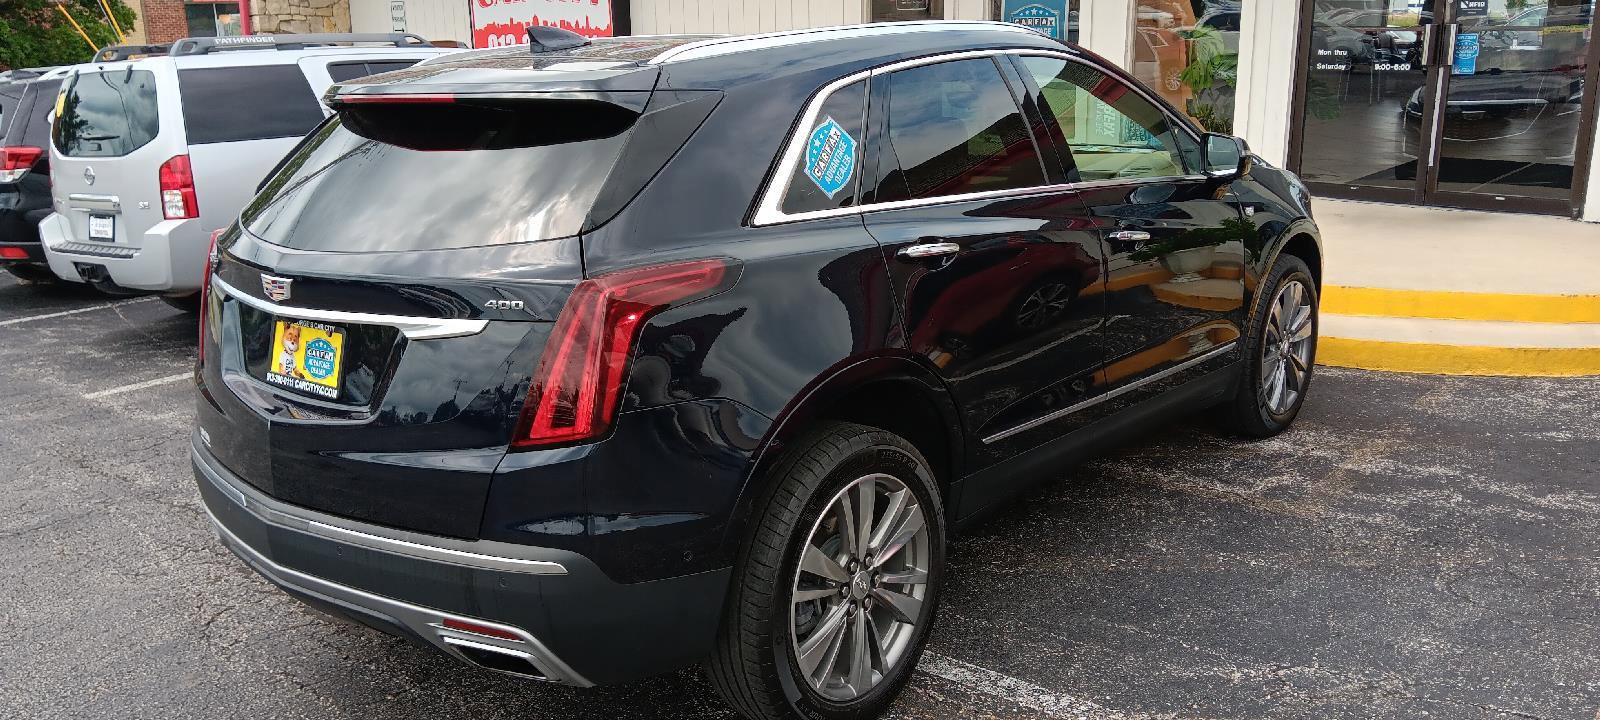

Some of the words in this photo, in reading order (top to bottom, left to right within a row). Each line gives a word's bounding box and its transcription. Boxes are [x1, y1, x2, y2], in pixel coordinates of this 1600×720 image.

[1014, 18, 1054, 26] CARFAX
[214, 36, 275, 44] PATHFINDER
[1316, 63, 1346, 71] Saturday
[814, 128, 840, 178] CARFAX
[825, 140, 847, 184] ADVANTAGE
[835, 155, 851, 184] DEALER
[484, 299, 524, 310] 400
